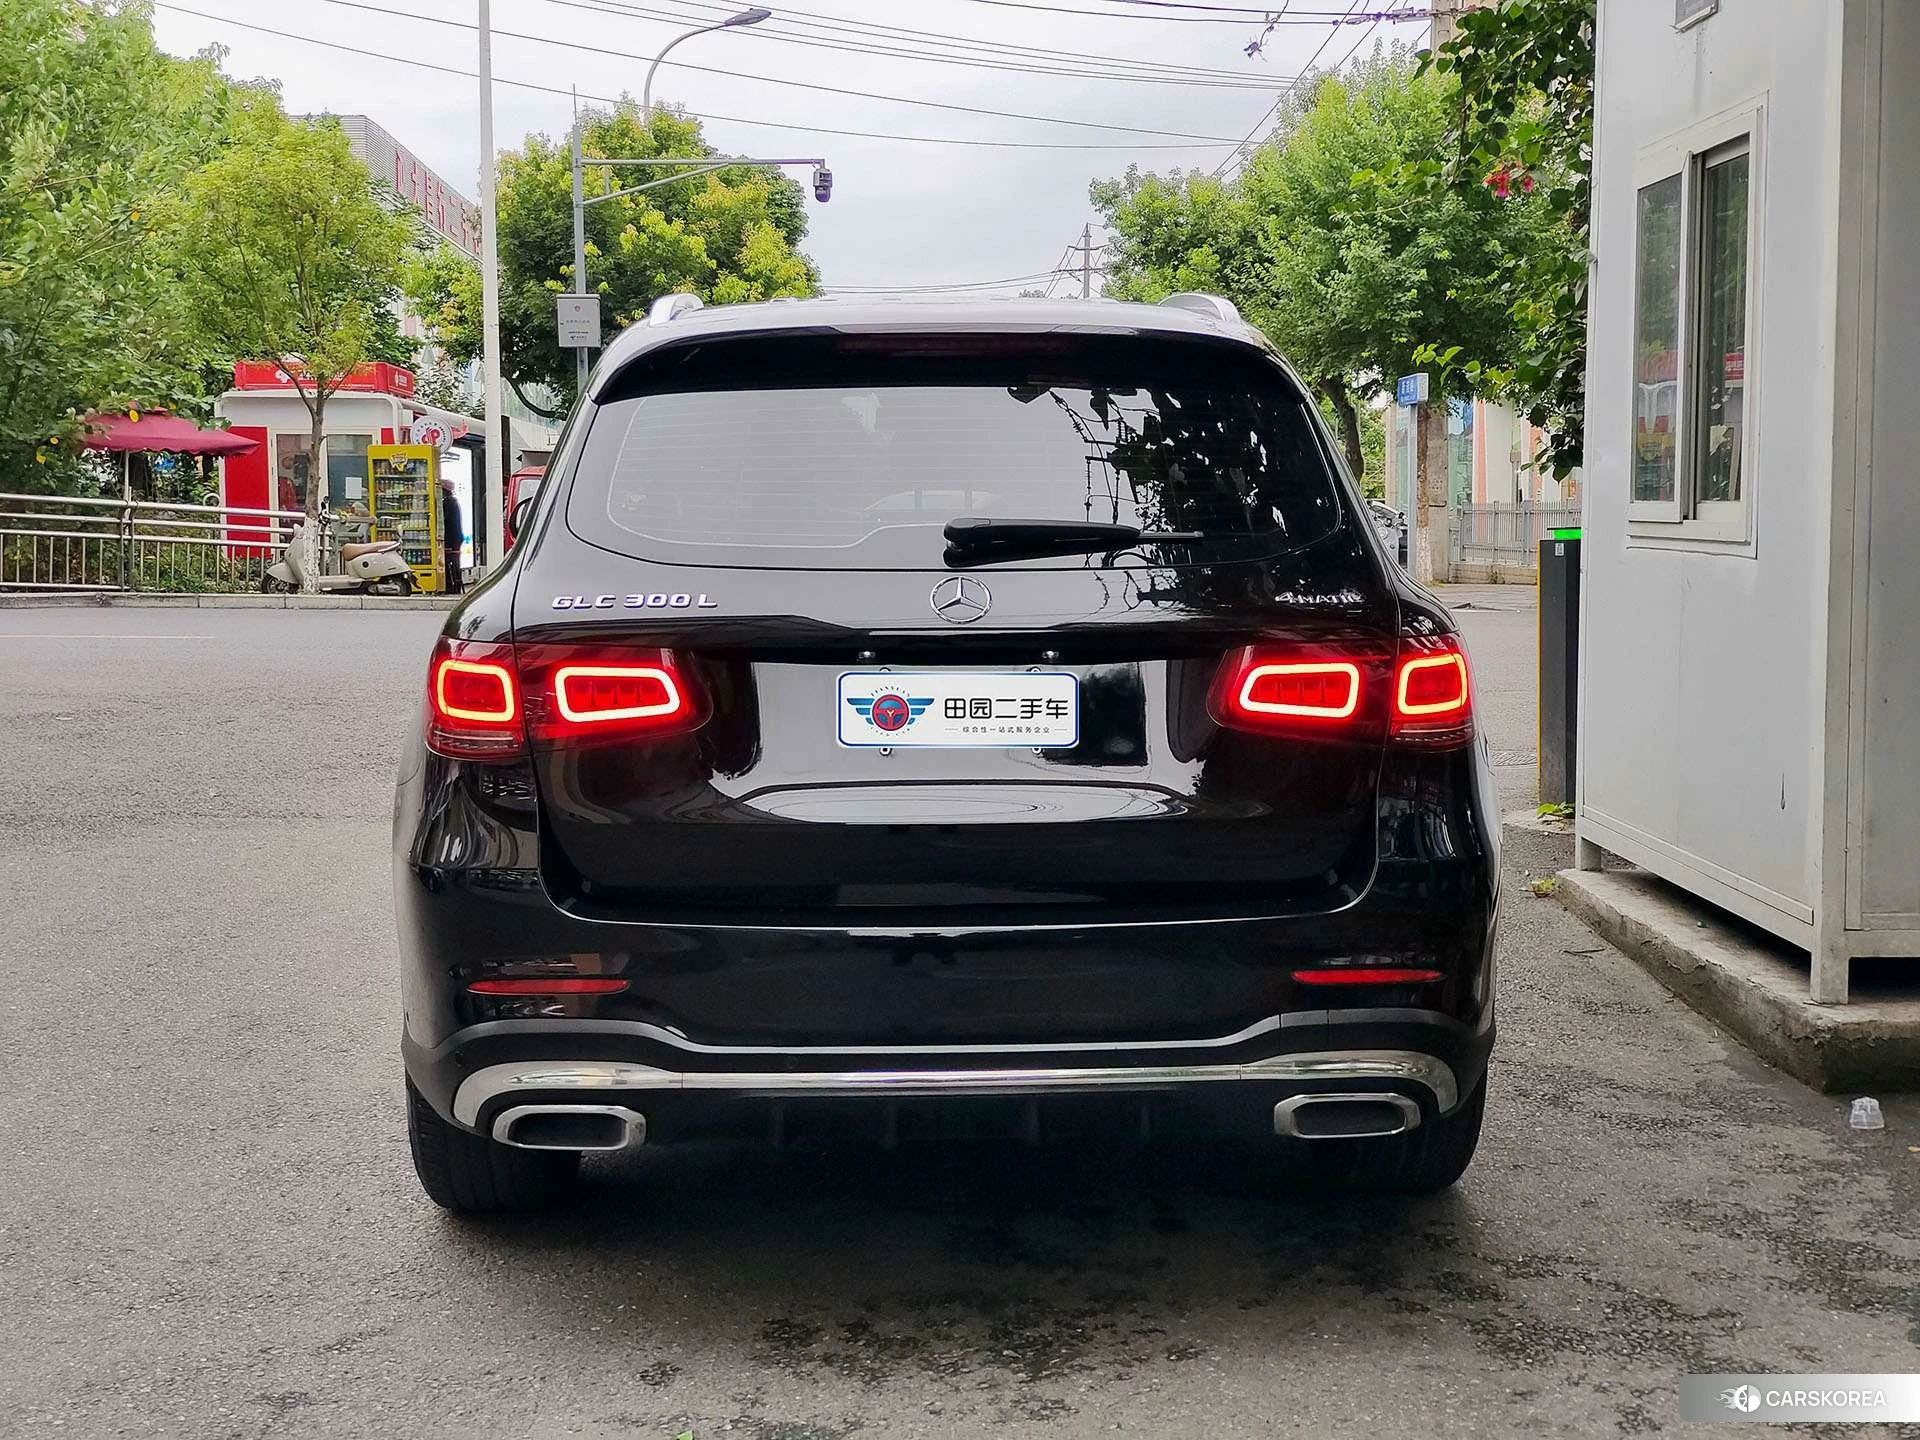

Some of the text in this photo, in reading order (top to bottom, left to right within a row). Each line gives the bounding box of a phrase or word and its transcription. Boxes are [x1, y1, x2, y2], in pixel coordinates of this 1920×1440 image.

[552, 593, 718, 610] GLC 300 L
[944, 698, 1068, 719] 田园二手车
